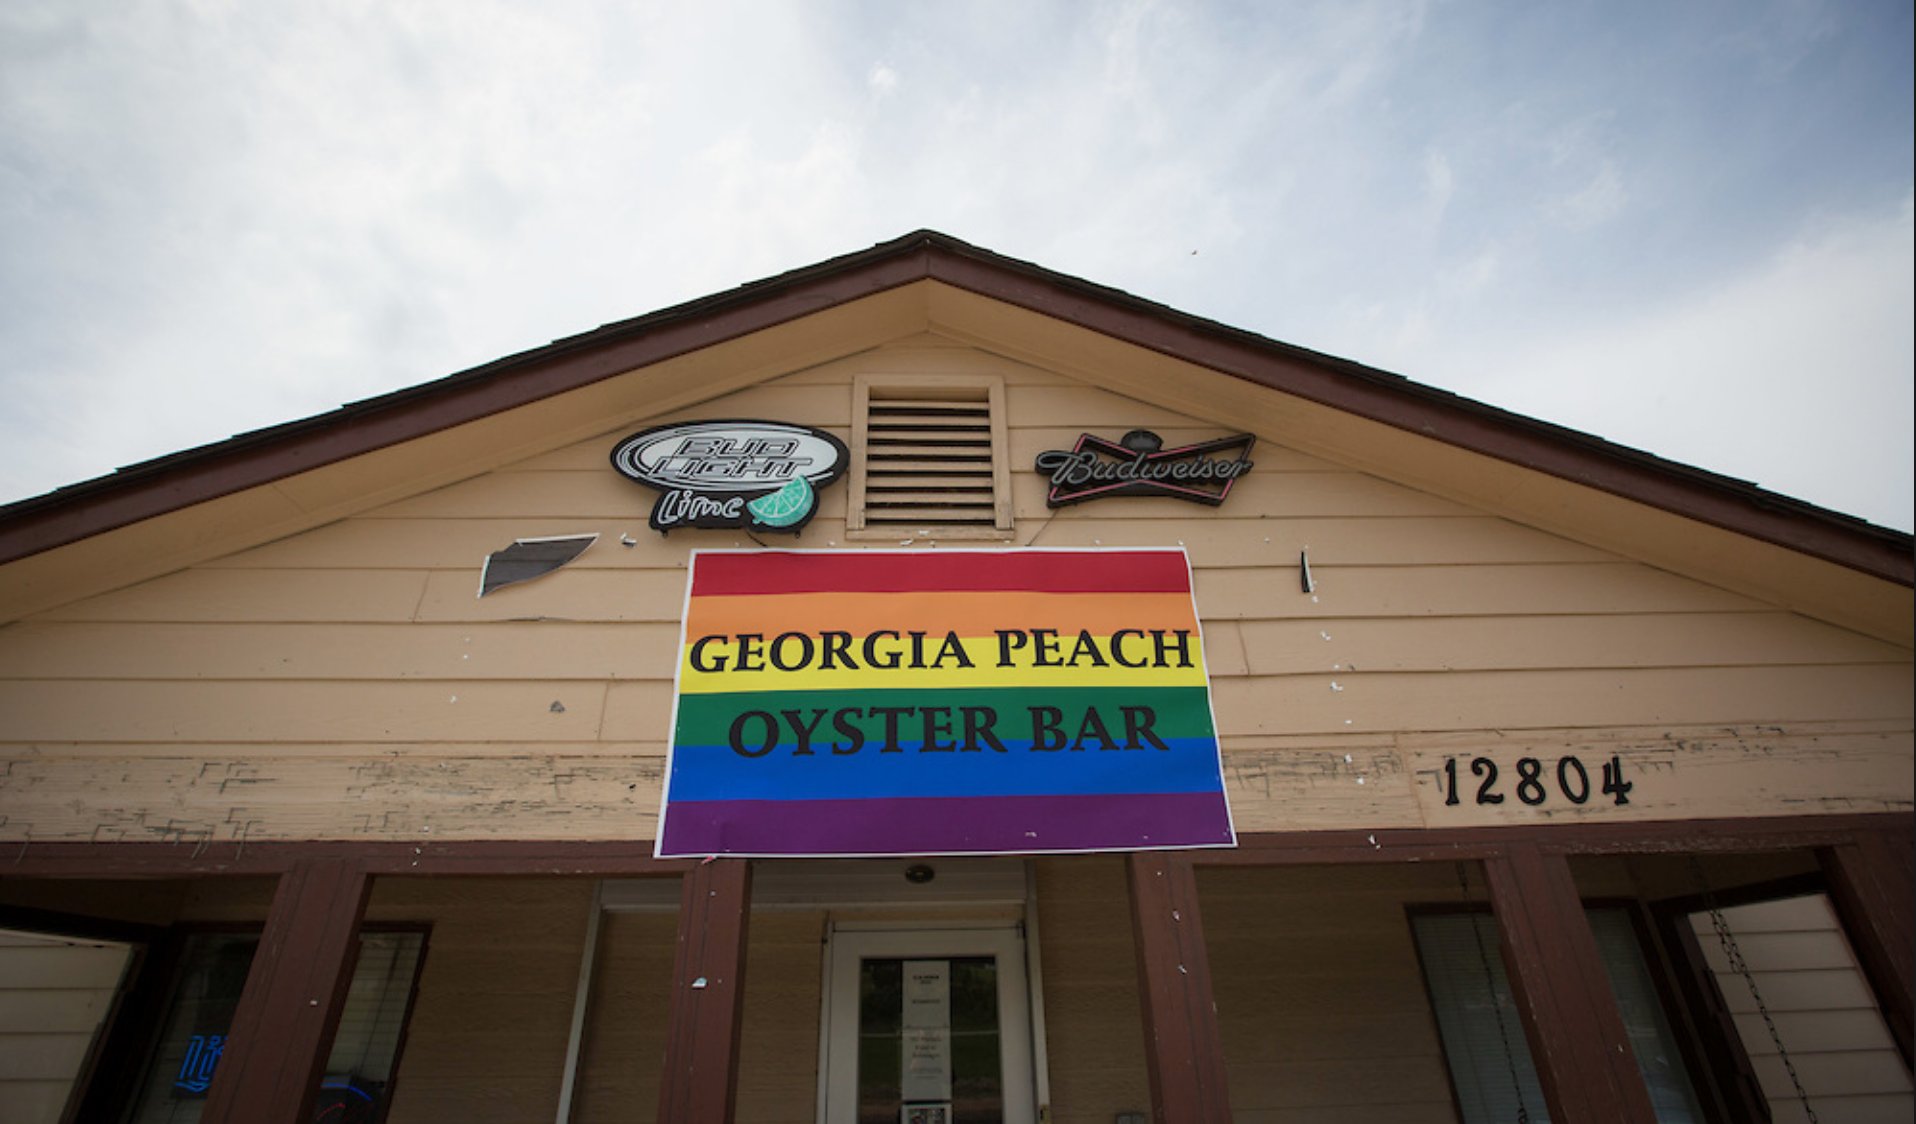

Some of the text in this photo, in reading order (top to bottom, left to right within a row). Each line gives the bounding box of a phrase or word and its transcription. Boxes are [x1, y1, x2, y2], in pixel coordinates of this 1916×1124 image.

[673, 436, 799, 458] BUD
[647, 456, 813, 478] LIGHT
[1036, 451, 1252, 485] Budweiser
[658, 490, 744, 524] Lime
[689, 628, 1195, 673] GEORGIA PEACH
[728, 705, 1170, 759] OYSTER BAR
[1444, 755, 1633, 806] 12804
